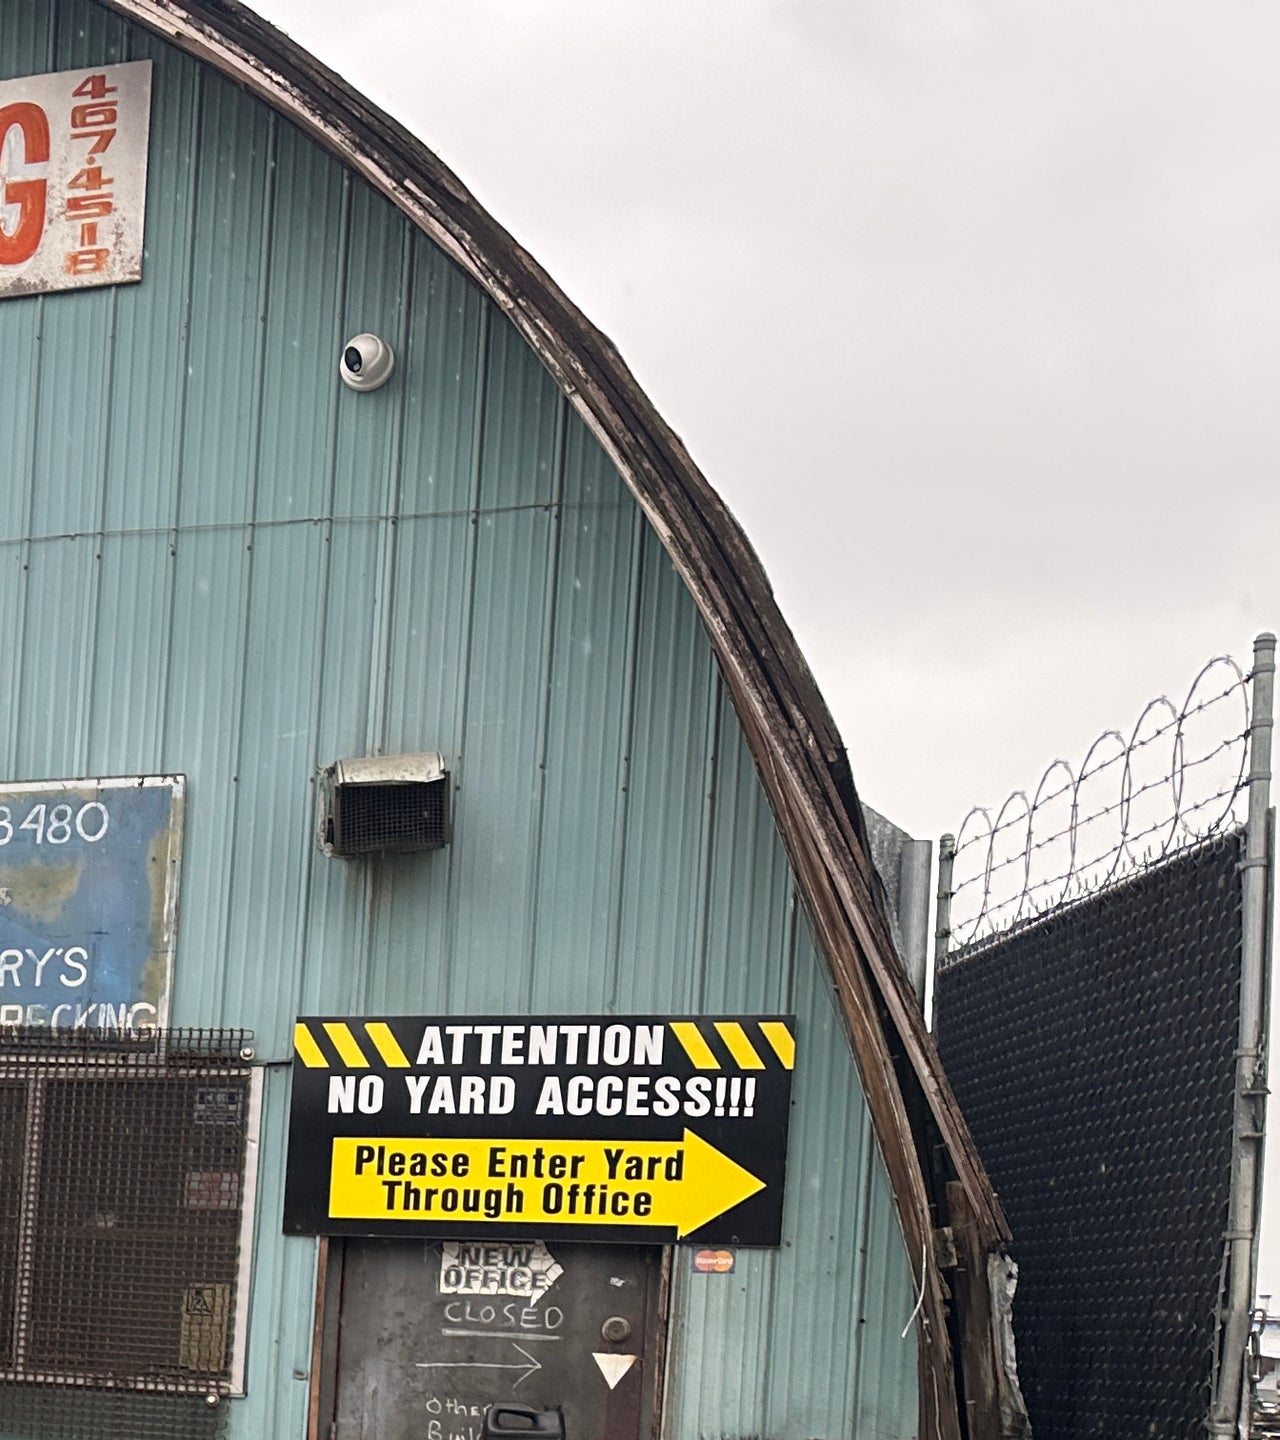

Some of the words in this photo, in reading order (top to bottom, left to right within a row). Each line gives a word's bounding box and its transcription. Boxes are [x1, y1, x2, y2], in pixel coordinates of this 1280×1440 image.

[416, 1024, 665, 1067] ATTENTION
[327, 1075, 385, 1115] NO
[405, 1075, 516, 1116] YARD
[535, 1076, 757, 1118] ACCESS!!!
[354, 1145, 469, 1178] Please
[487, 1146, 586, 1181] Enter
[604, 1148, 685, 1182] Yard
[381, 1180, 524, 1219] Through
[542, 1185, 653, 1217] Office
[460, 1245, 533, 1267] NEW
[443, 1265, 548, 1291] OFFICE
[444, 1302, 564, 1329] CLOSED
